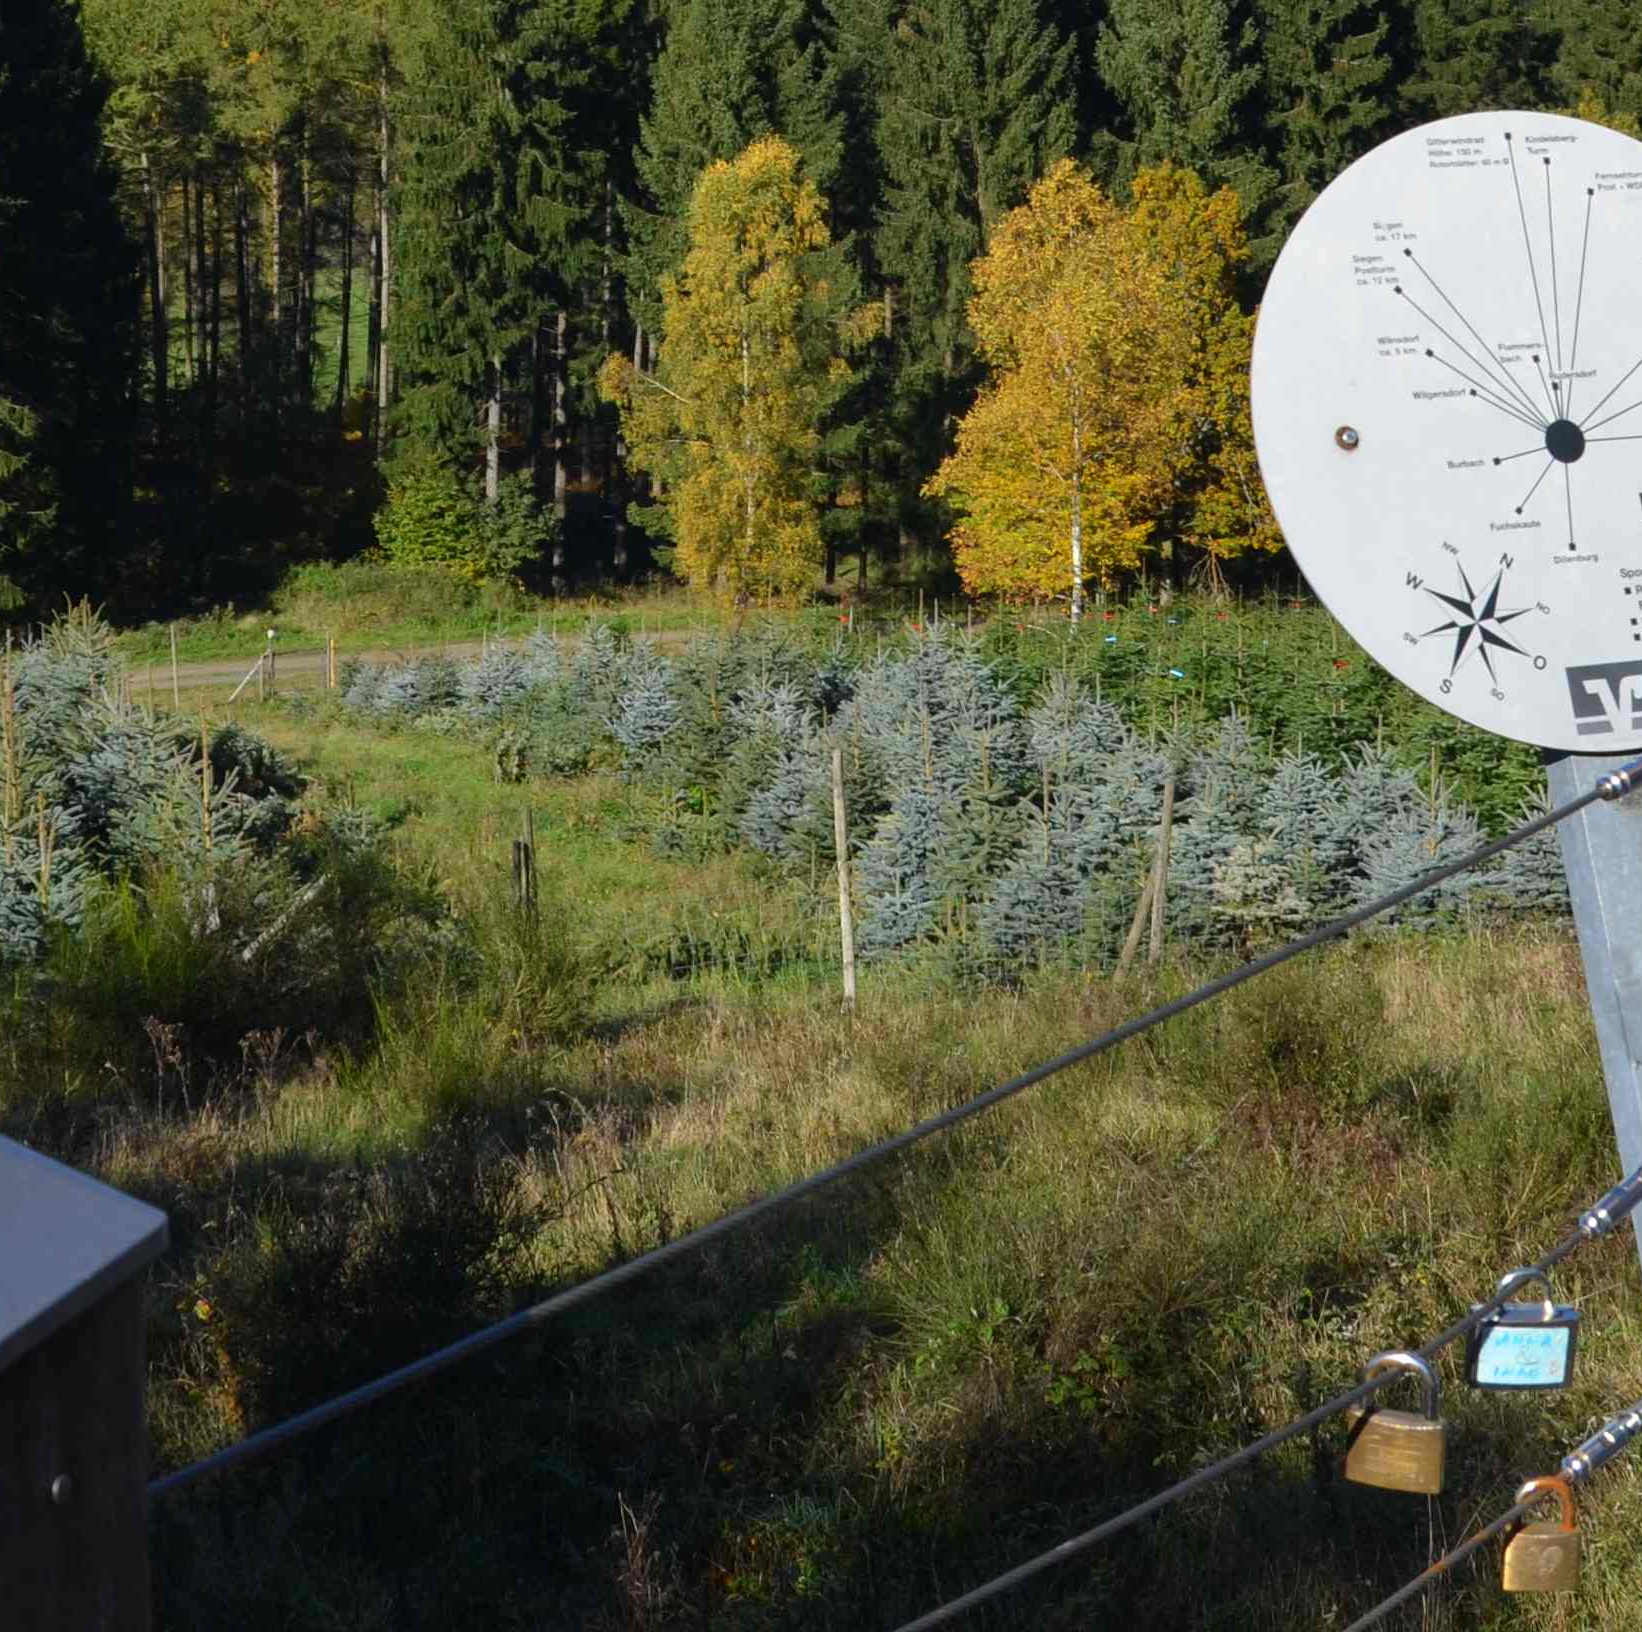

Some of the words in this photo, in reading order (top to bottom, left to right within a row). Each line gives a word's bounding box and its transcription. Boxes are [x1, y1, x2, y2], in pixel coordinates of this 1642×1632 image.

[1499, 552, 1514, 569] N
[1405, 571, 1424, 590] W
[1533, 655, 1547, 670] O
[1440, 679, 1453, 694] S
